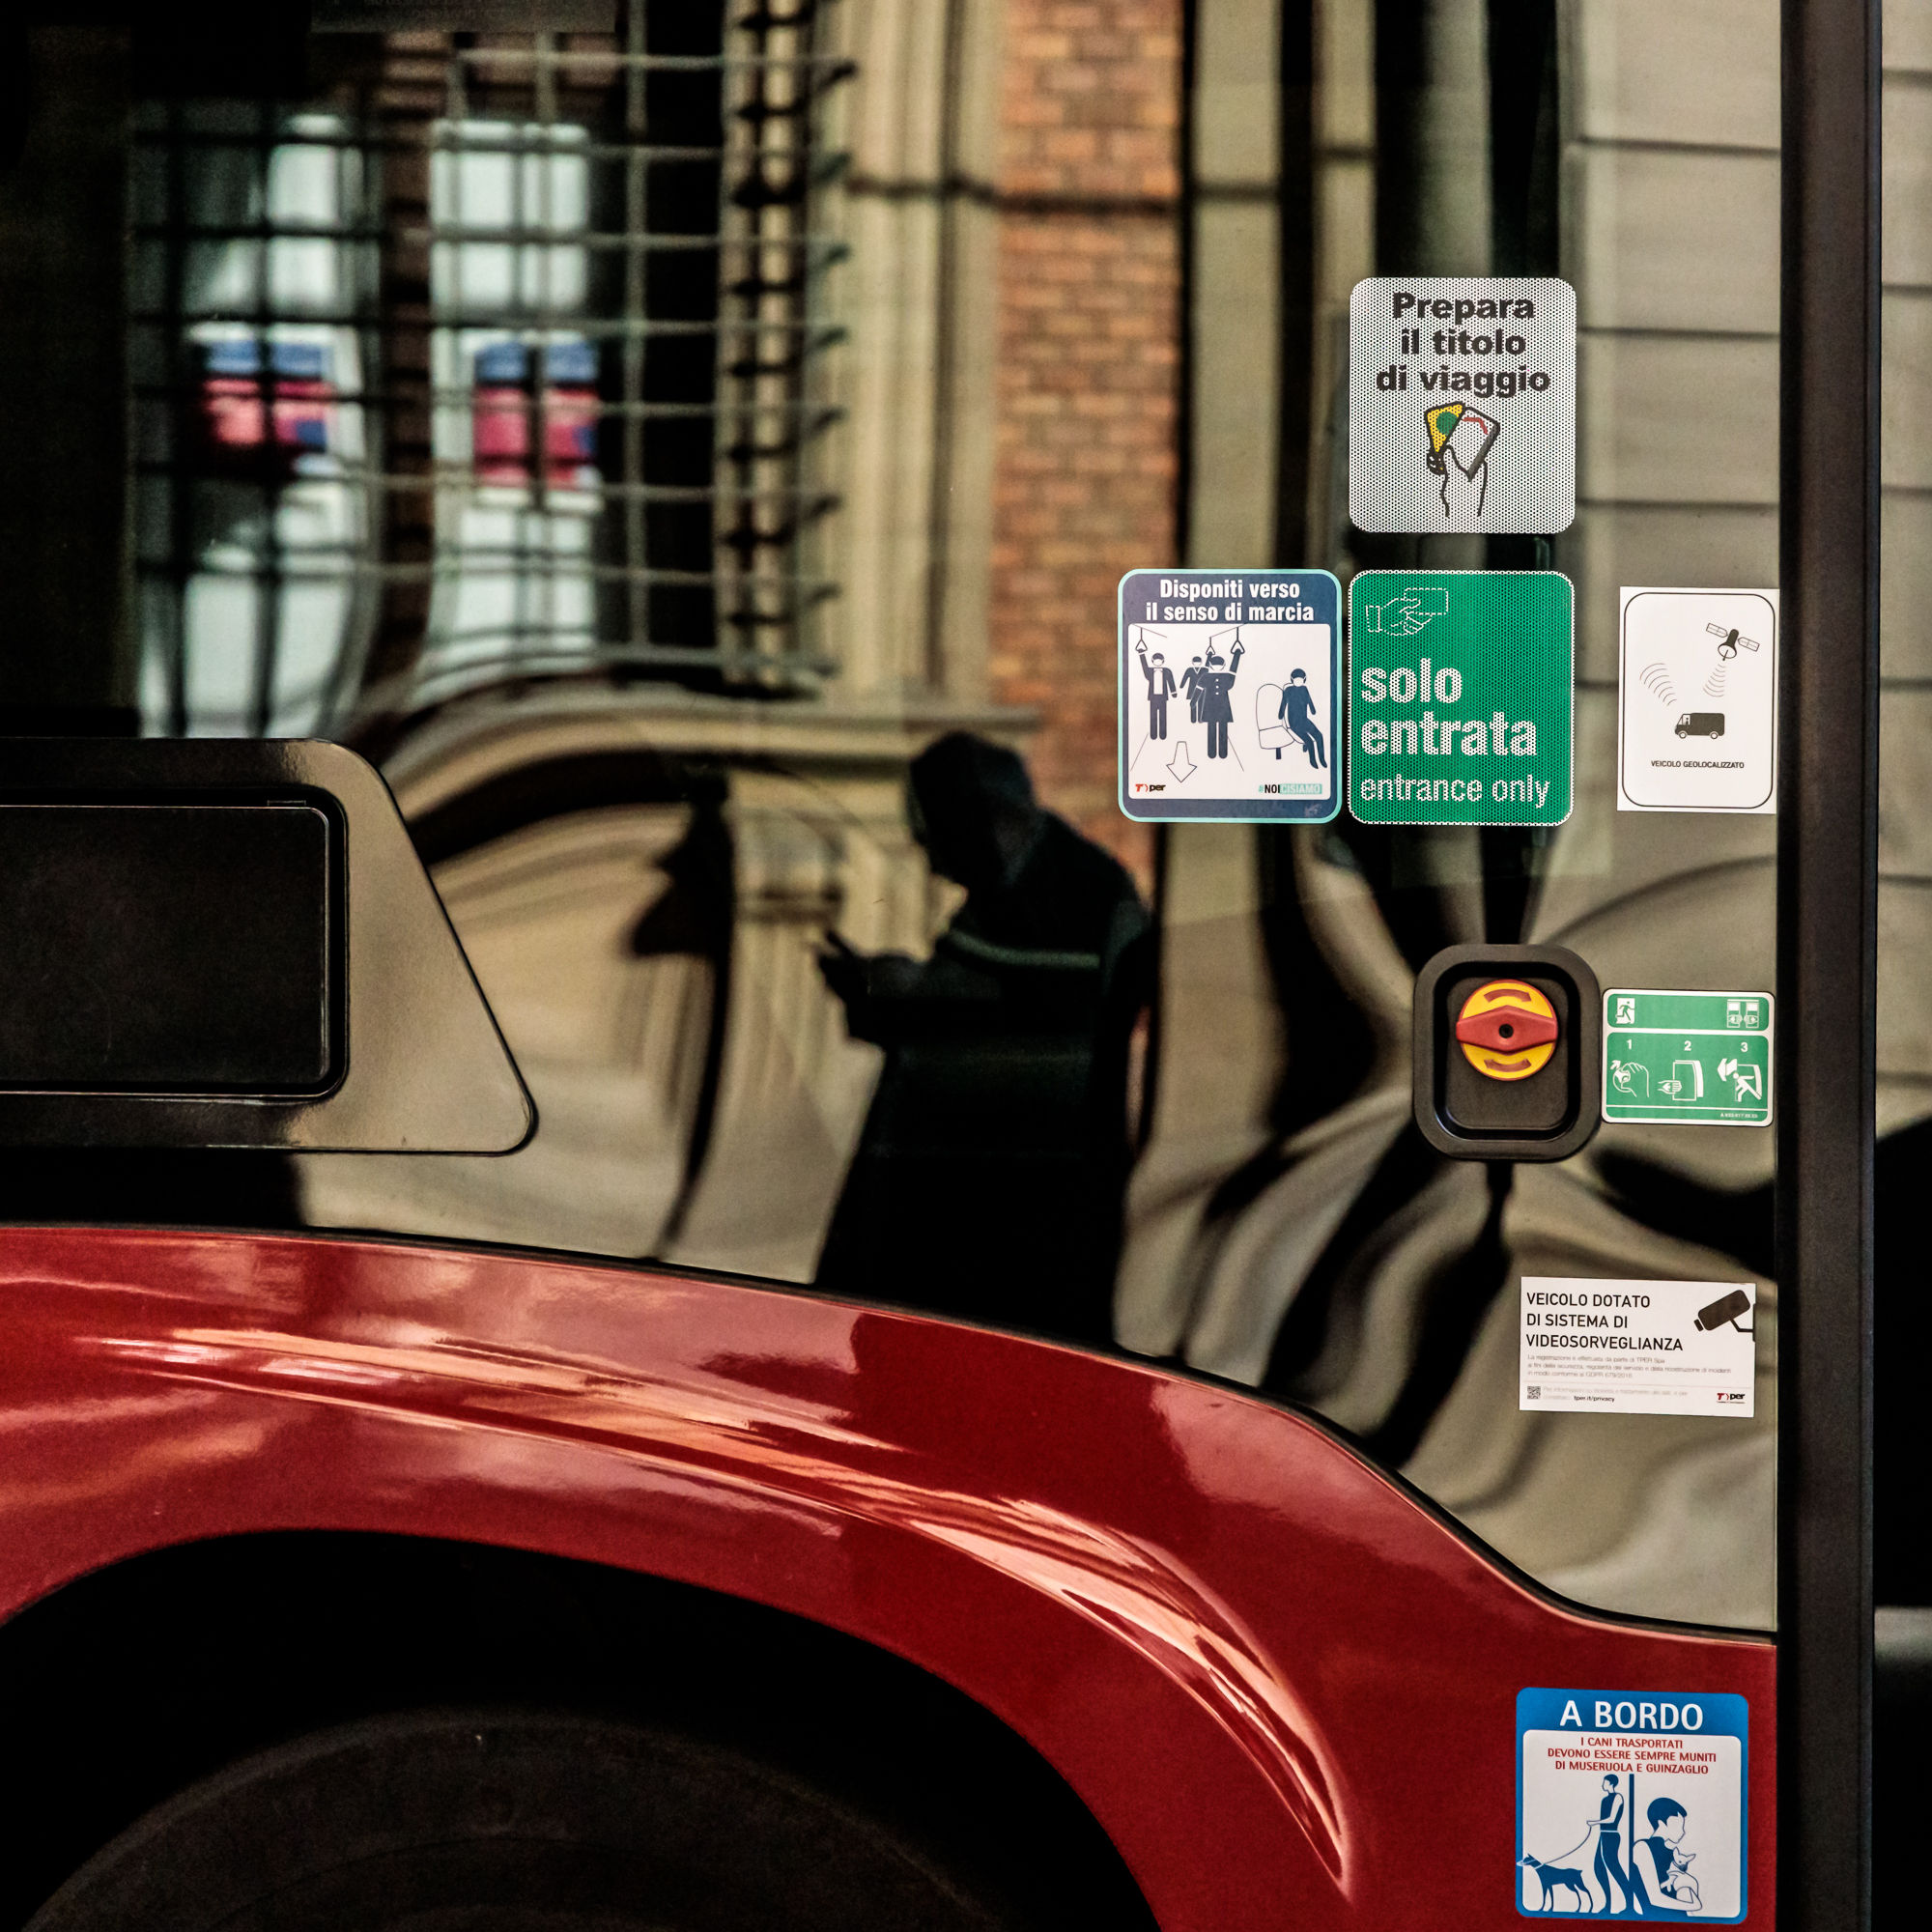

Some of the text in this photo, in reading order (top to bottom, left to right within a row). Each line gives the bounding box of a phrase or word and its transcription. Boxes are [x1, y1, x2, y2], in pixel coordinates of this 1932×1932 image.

[1392, 291, 1535, 326] Prepara
[1401, 327, 1526, 356] il titolo
[1376, 364, 1551, 398] di viaggio
[1160, 579, 1300, 602] Disponiti verso
[1146, 602, 1315, 621] il senso di marcia
[1361, 658, 1463, 703] solo
[1361, 711, 1537, 756] entrata
[1360, 774, 1550, 809] entrance only
[1626, 1039, 1633, 1050] 1
[1684, 1040, 1691, 1051] 2
[1741, 1041, 1748, 1052] 3
[1526, 1293, 1651, 1308] VEICOLO DOTATO
[1526, 1314, 1628, 1328] DI SISTEMA DI
[1526, 1334, 1684, 1351] VIDEOSORVEGLIANZA
[1559, 1699, 1704, 1731] A BORDO
[1580, 1737, 1684, 1749] I CANI TRASPORTATI
[1548, 1747, 1717, 1763] DEVONO ESSERE SEMPRE MUNITI
[1555, 1761, 1709, 1775] DI MUSERUOLA E GUINZAGLIO
